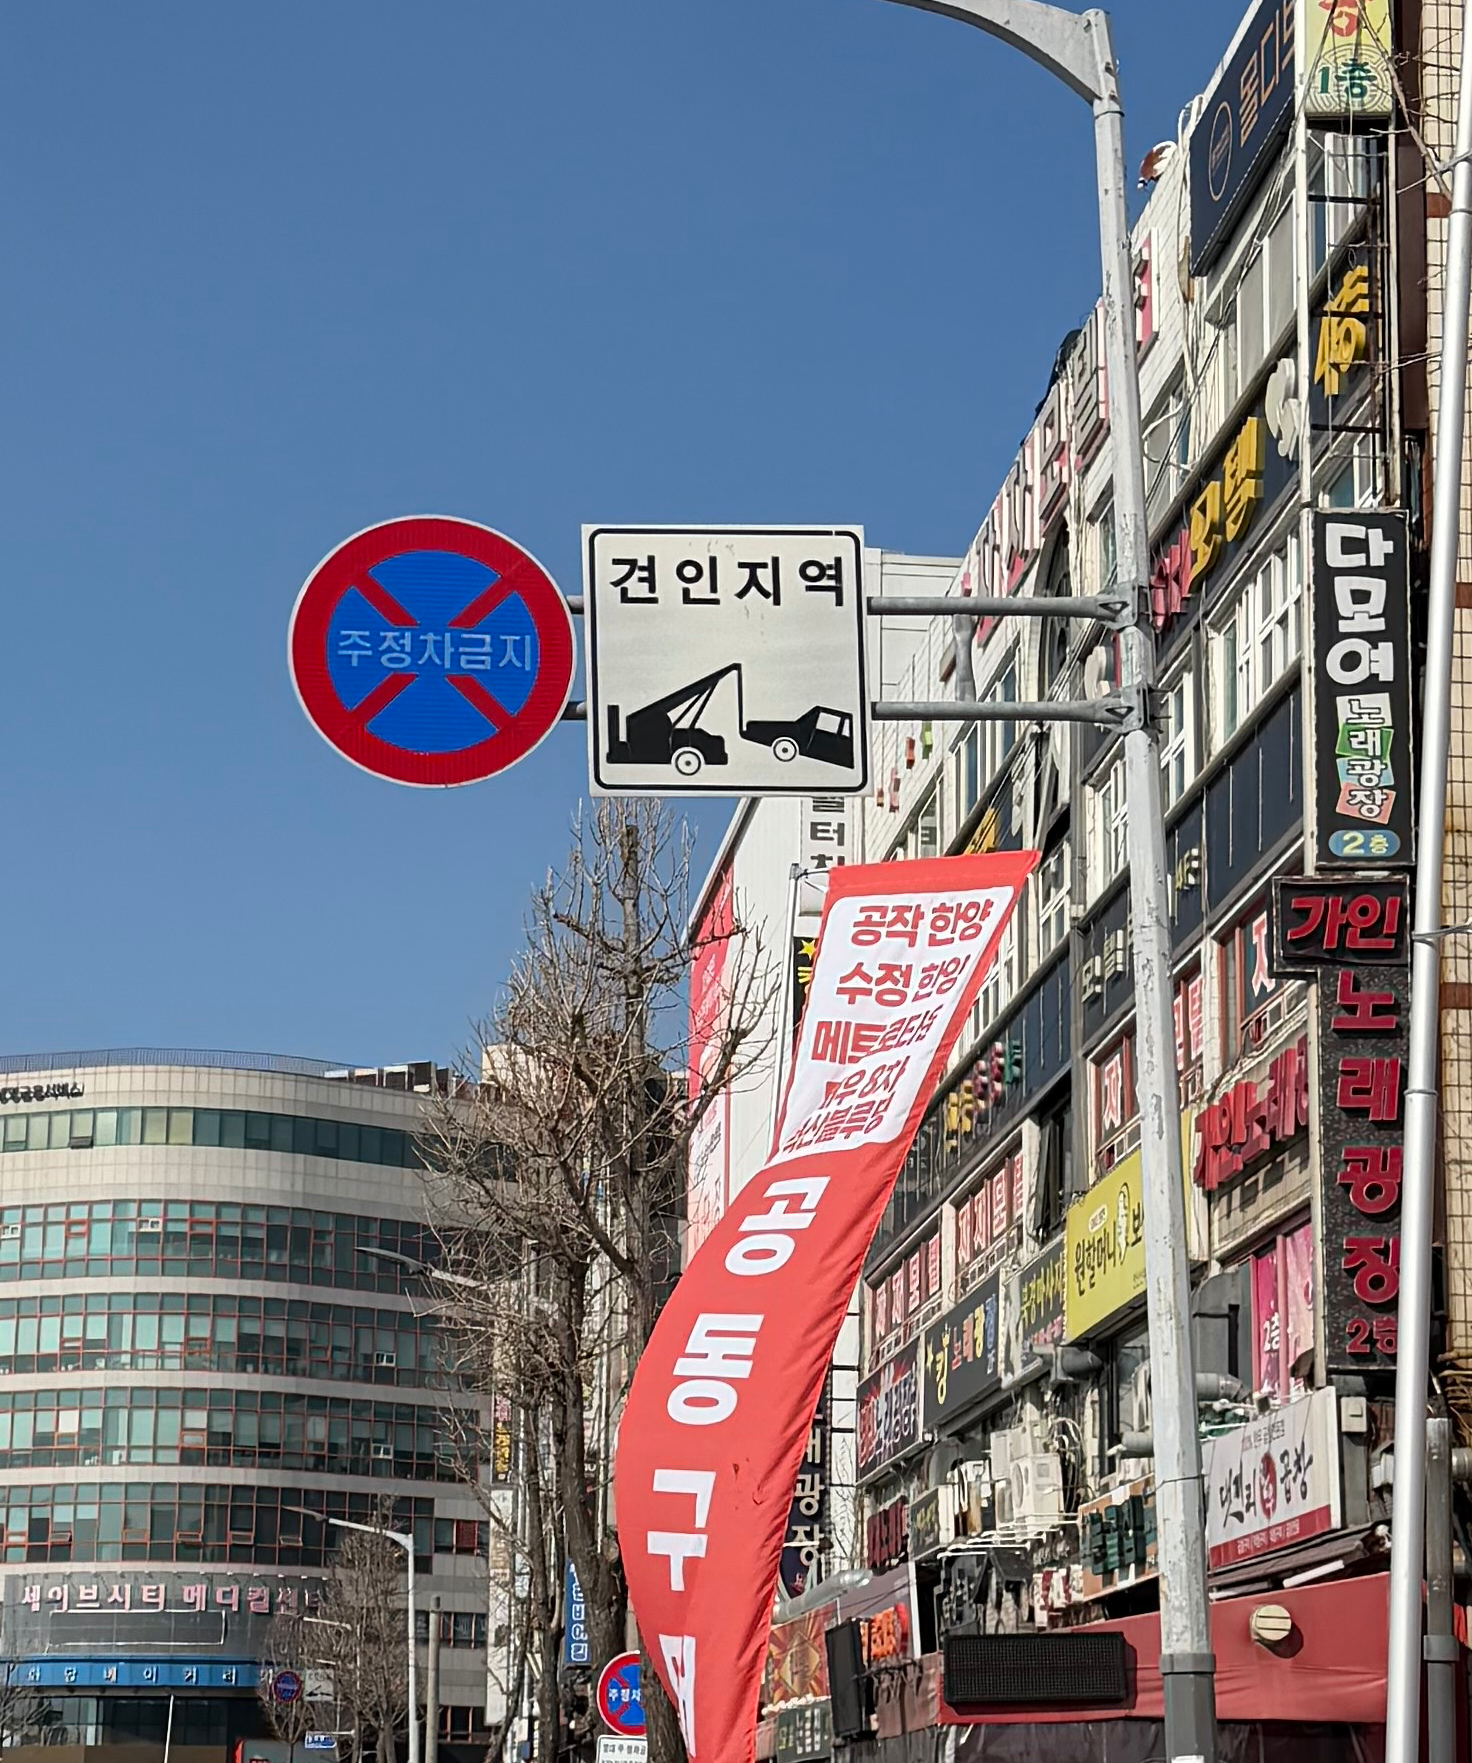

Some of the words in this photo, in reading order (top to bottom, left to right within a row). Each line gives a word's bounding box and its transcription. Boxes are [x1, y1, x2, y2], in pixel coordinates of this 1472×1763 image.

[1317, 55, 1377, 101] 1층
[609, 555, 844, 607] 견인지역
[1326, 522, 1395, 686] 다모여
[337, 629, 533, 672] 주정차금지
[1345, 697, 1389, 820] 노래광장
[1342, 829, 1390, 855] 2층
[850, 901, 925, 949] 공작
[927, 897, 995, 948] 한양
[1286, 893, 1401, 950] 가인
[835, 961, 913, 1008] 수정
[1331, 969, 1402, 1306] 노래광장
[1073, 1231, 1117, 1298] 원할머니
[21, 1583, 166, 1613] 세이브시티
